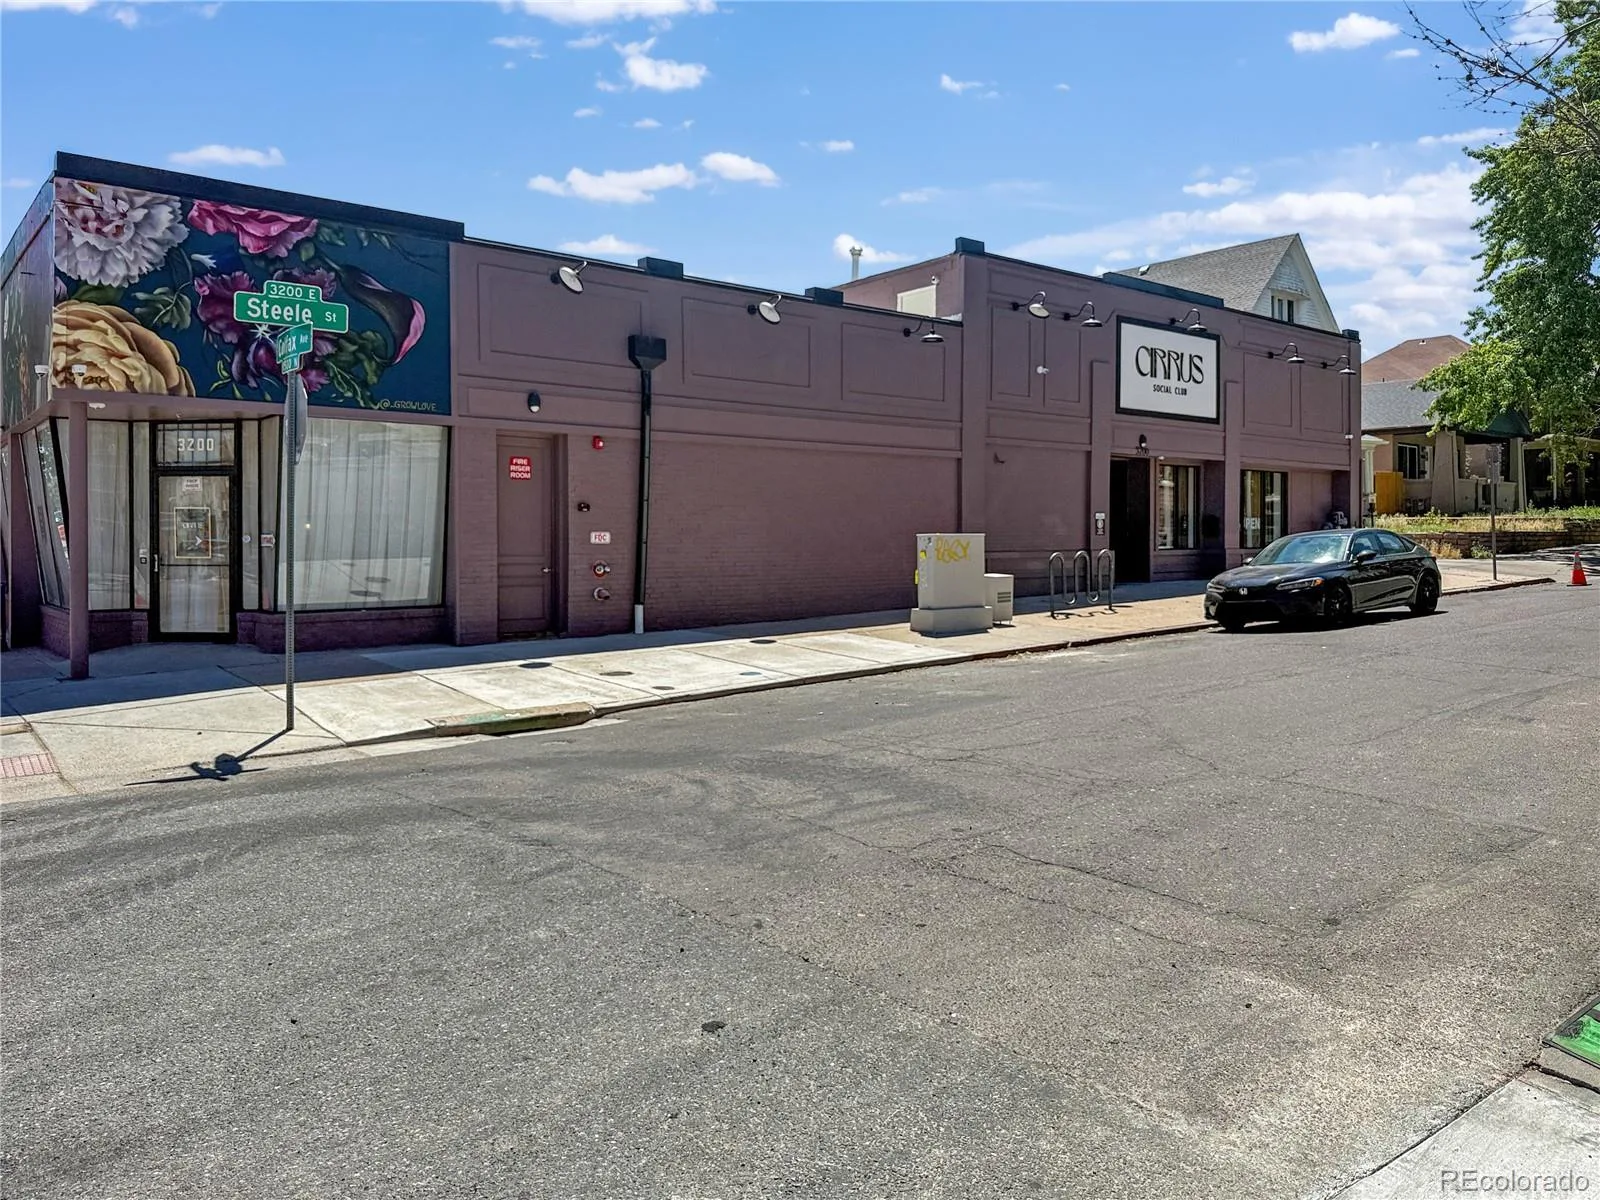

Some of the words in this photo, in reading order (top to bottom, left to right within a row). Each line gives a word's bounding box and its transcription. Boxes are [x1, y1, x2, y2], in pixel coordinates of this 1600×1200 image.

[270, 284, 302, 297] 3200
[309, 289, 316, 299] E
[247, 297, 312, 322] Steele
[325, 311, 336, 322] St
[1135, 345, 1204, 384] CIRRUS
[1152, 384, 1172, 394] SOCIAL
[1174, 387, 1187, 395] CLUB
[178, 438, 214, 451] 3200
